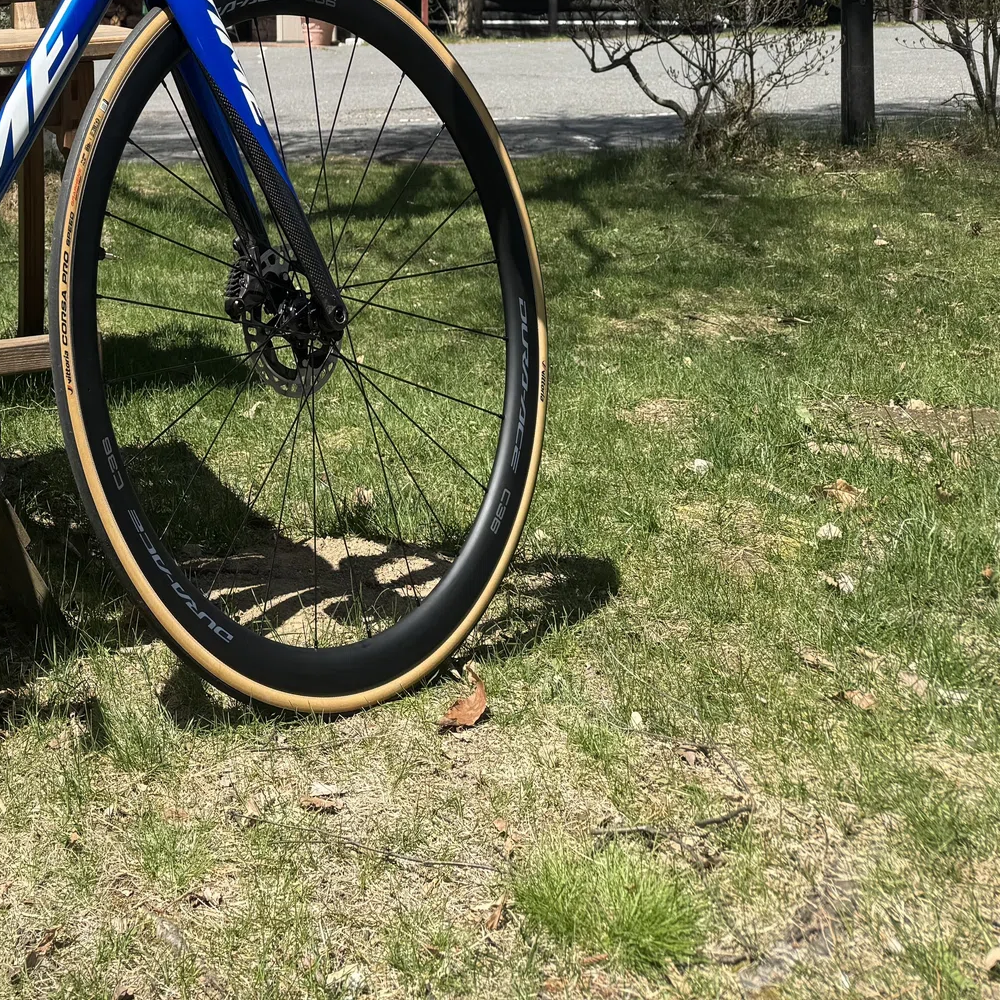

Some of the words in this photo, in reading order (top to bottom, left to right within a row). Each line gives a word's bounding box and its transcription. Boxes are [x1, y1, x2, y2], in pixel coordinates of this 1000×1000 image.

[65, 211, 75, 247] SPEED
[62, 251, 71, 285] PRO
[61, 290, 69, 346] CORSA
[64, 350, 73, 384] vittoria
[510, 297, 529, 474] DURA-ACE
[101, 436, 125, 491] C36
[490, 487, 512, 535] C36
[127, 509, 235, 644] DURA-ACE
